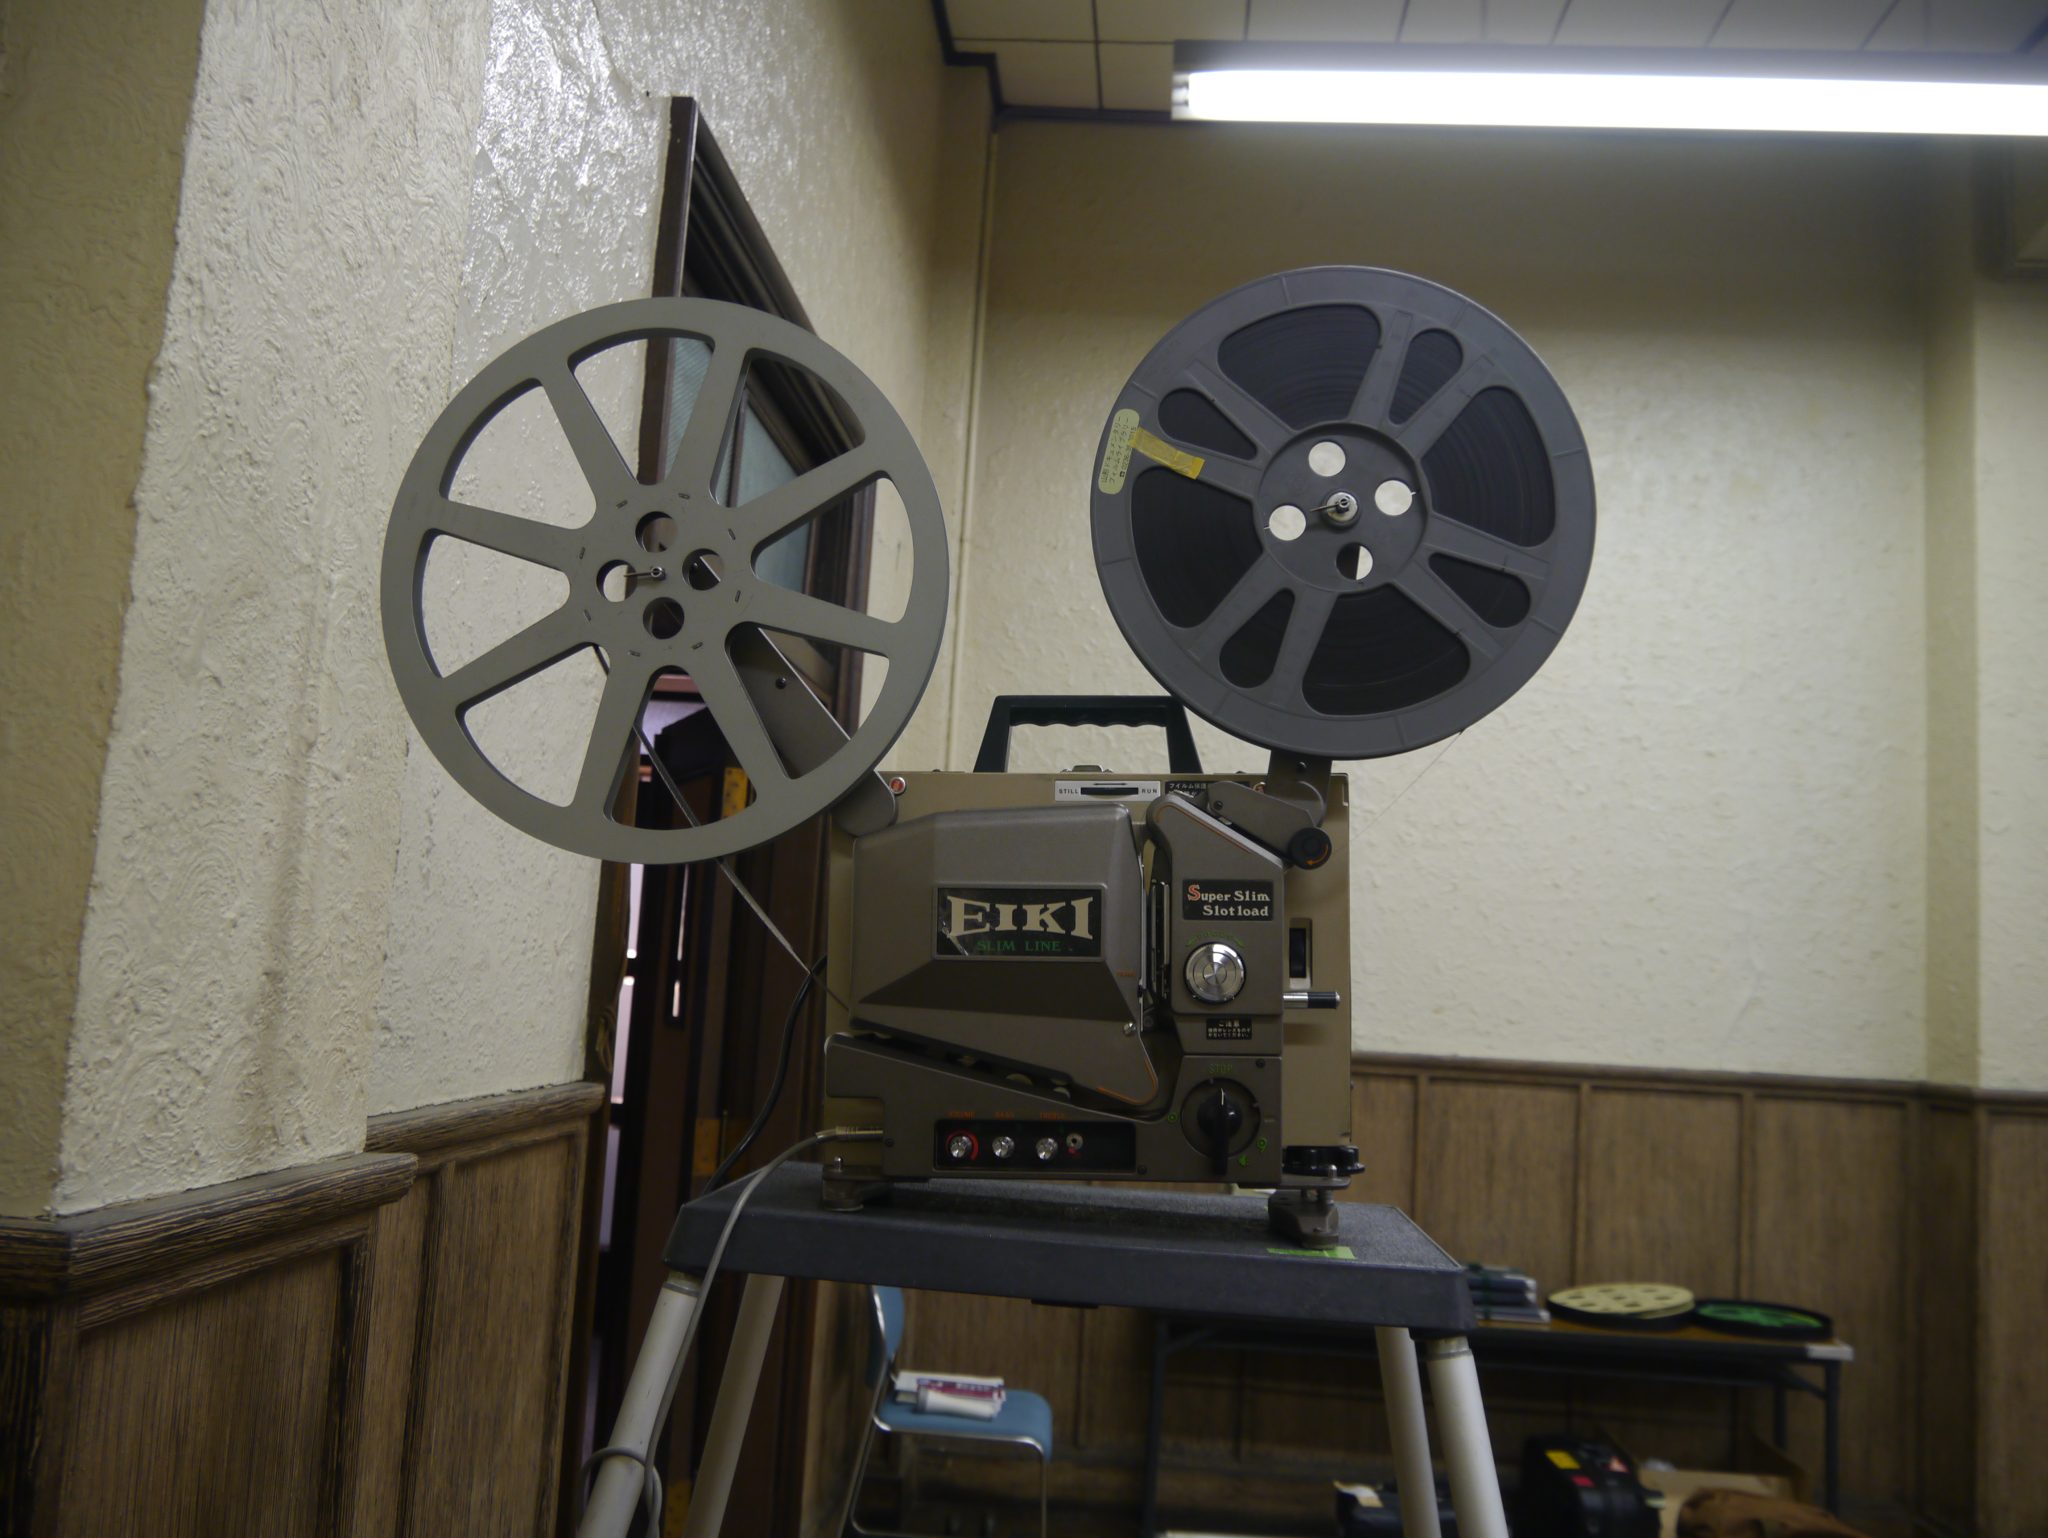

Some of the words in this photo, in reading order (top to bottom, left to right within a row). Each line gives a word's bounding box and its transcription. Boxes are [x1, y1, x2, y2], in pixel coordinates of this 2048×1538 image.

[1187, 884, 1232, 902] Super
[1234, 891, 1270, 902] Slim
[946, 895, 1094, 940] EIKI
[976, 940, 1016, 953] SLIM
[1024, 940, 1062, 953] LINE
